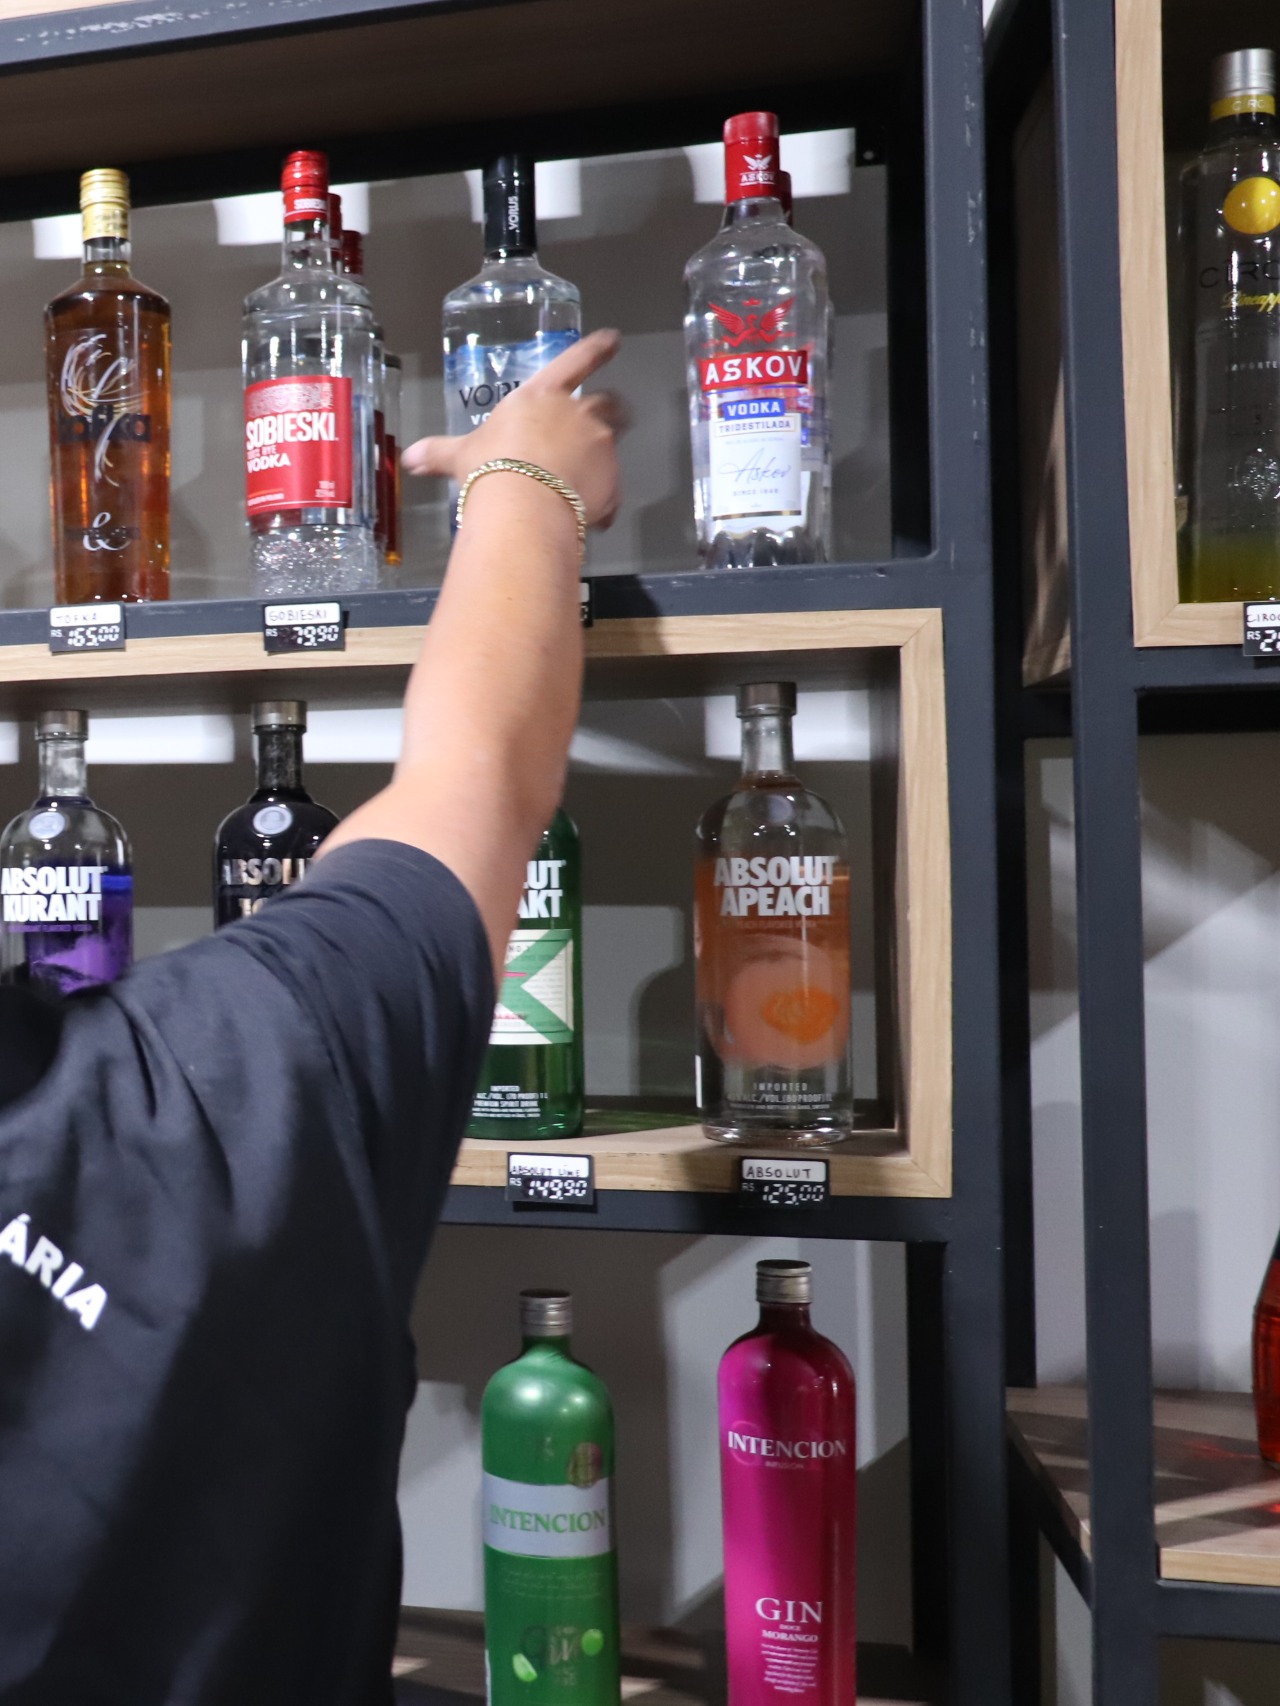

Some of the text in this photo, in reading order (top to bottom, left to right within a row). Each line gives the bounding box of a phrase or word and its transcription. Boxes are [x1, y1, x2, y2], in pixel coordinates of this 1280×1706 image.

[741, 172, 775, 183] ASKOV
[508, 196, 519, 230] VORUS
[705, 354, 803, 386] ASKOV
[459, 380, 523, 409] VOR
[726, 400, 781, 417] VODKA
[246, 411, 337, 451] SOBIESKI
[719, 421, 792, 434] TRIDESTILADA
[247, 452, 291, 474] VODKA
[1, 866, 106, 895] ABSOLUT
[220, 857, 313, 887] ABSOLU
[714, 855, 838, 888] ABSOLUT
[3, 892, 102, 922] KURANT
[720, 885, 830, 916] APEACH
[753, 1082, 808, 1092] IMPORTED
[746, 1165, 812, 1179] ABSOLUT
[727, 1430, 847, 1459] INTENCION
[489, 1504, 607, 1534] INTENCION
[754, 1597, 823, 1624] GIN
[761, 1628, 819, 1643] MORANGO
